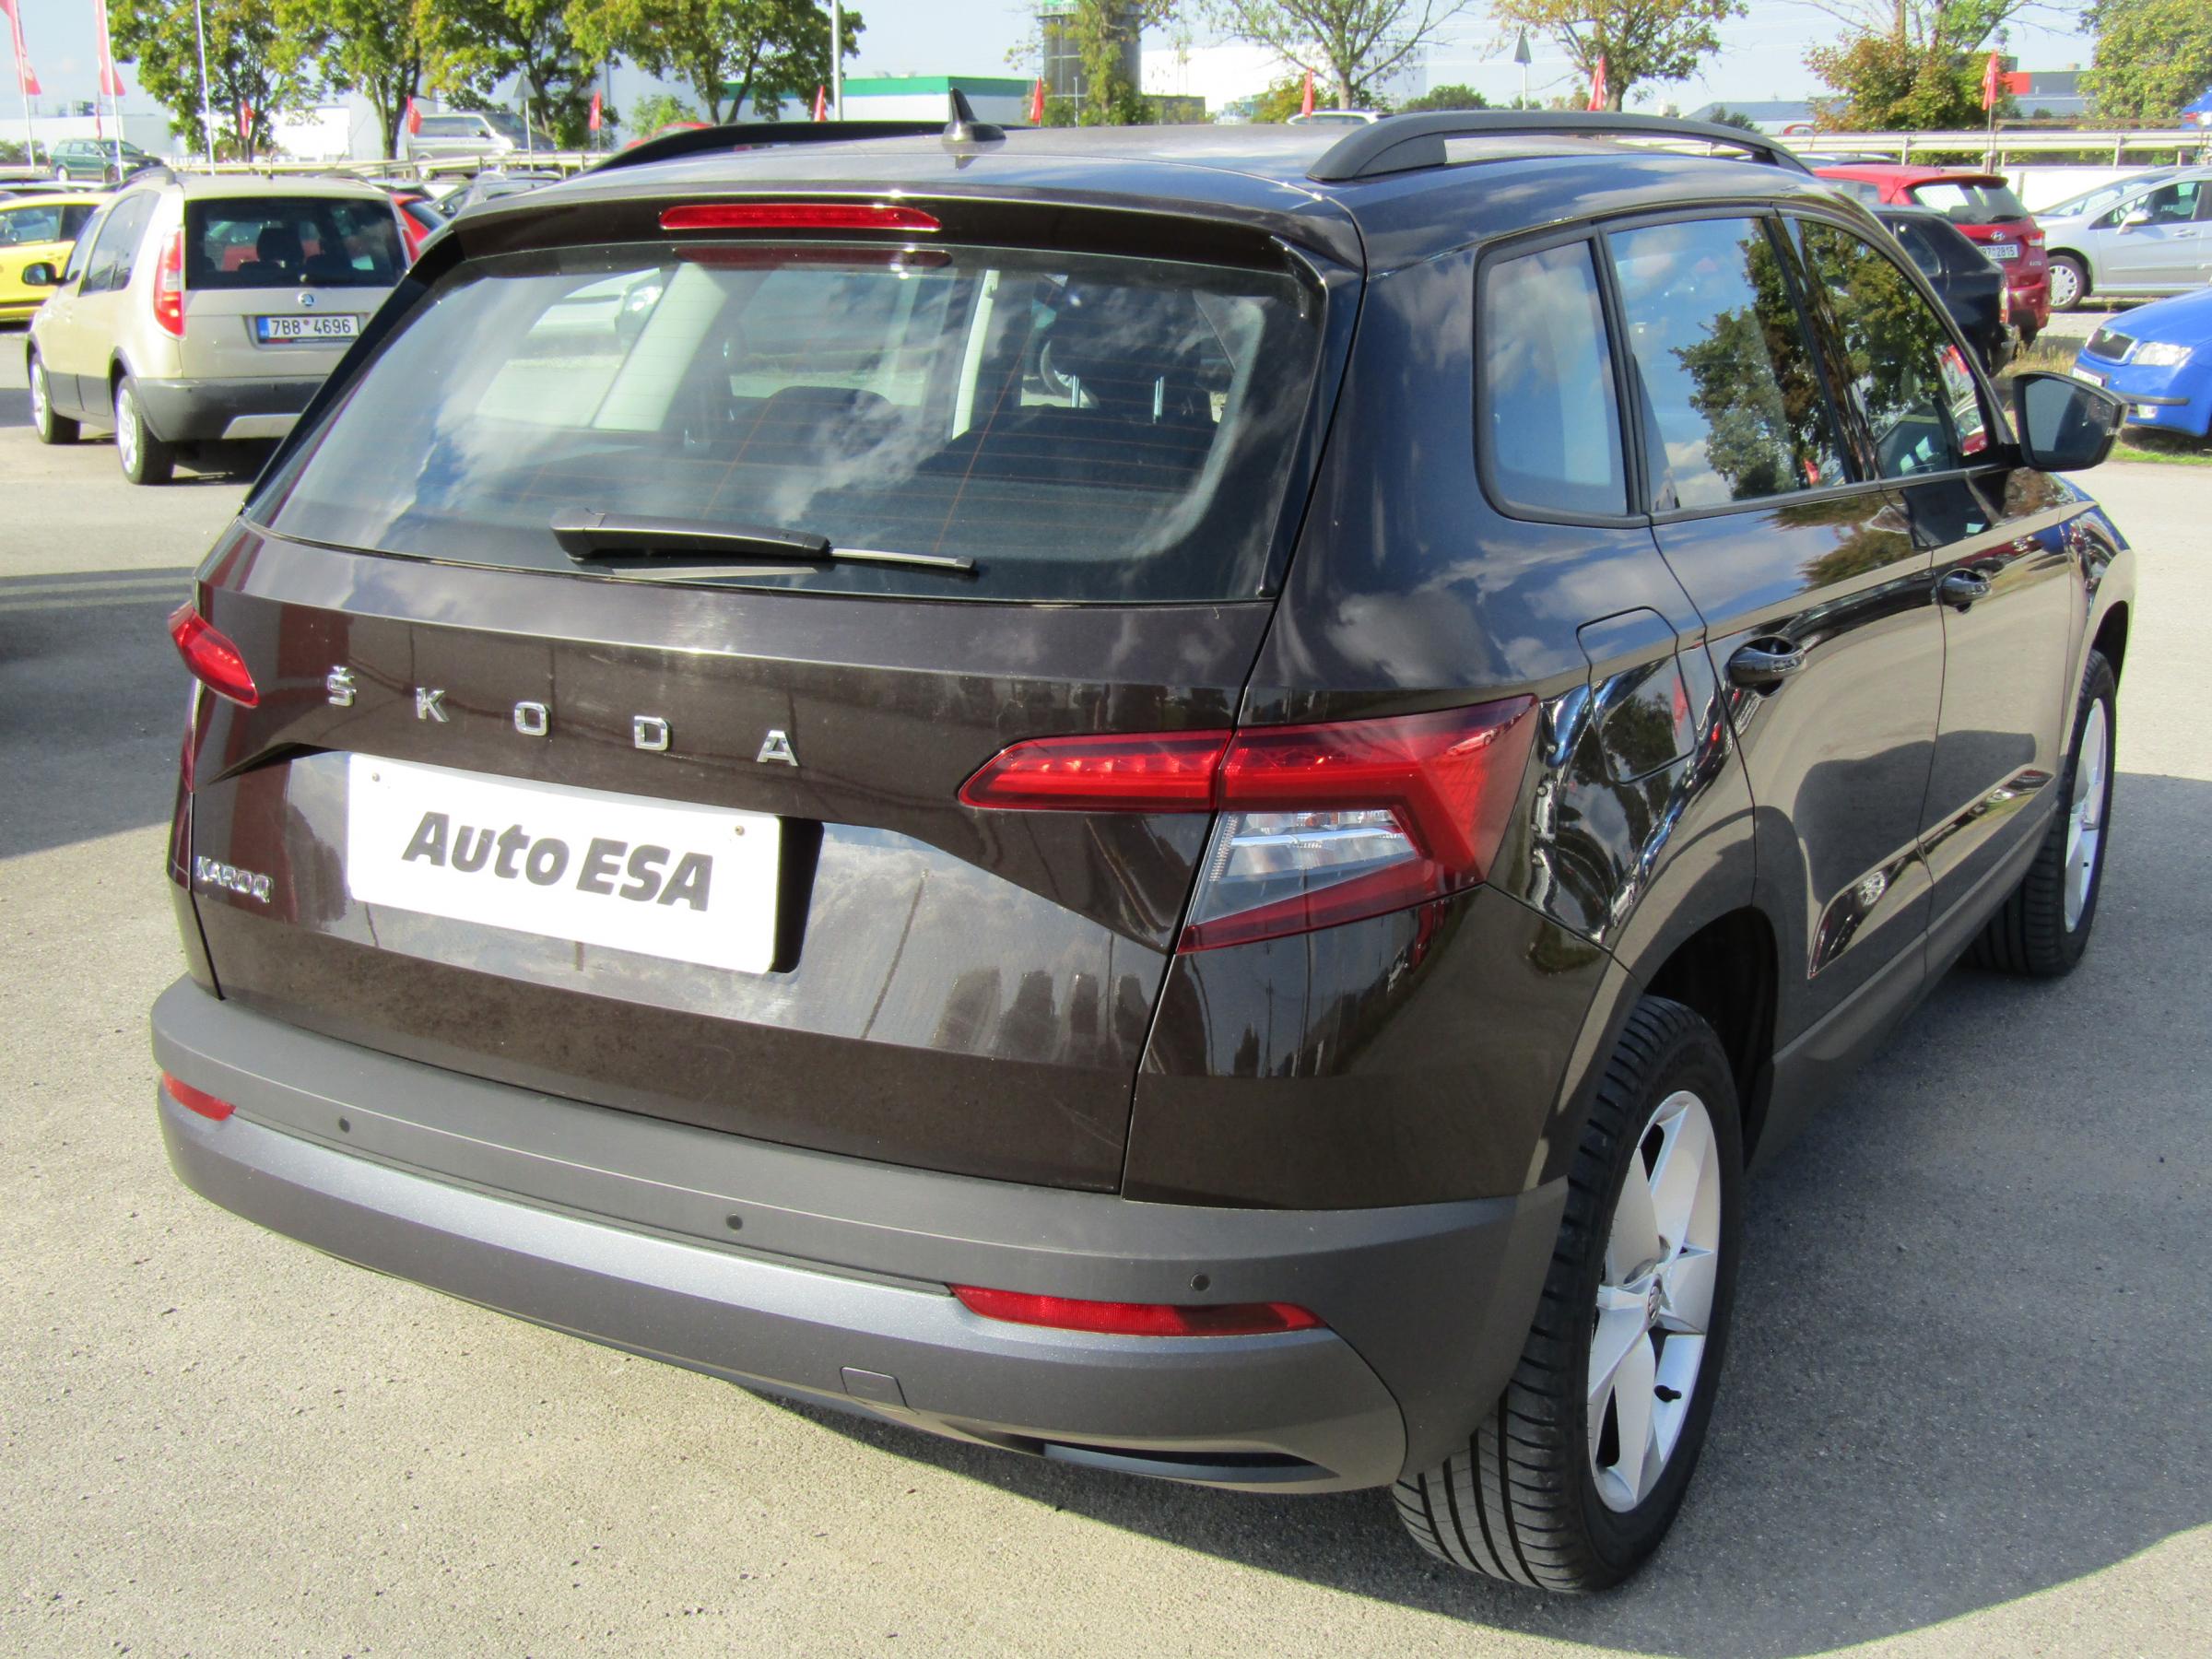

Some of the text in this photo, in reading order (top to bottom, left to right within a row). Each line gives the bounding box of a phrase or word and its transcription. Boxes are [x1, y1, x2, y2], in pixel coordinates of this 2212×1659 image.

[271, 319, 301, 335] 7B8
[313, 318, 351, 335] 4696
[326, 665, 800, 768] ŠKODA
[195, 855, 273, 903] KAROQ
[402, 810, 714, 912] Auto ESA
